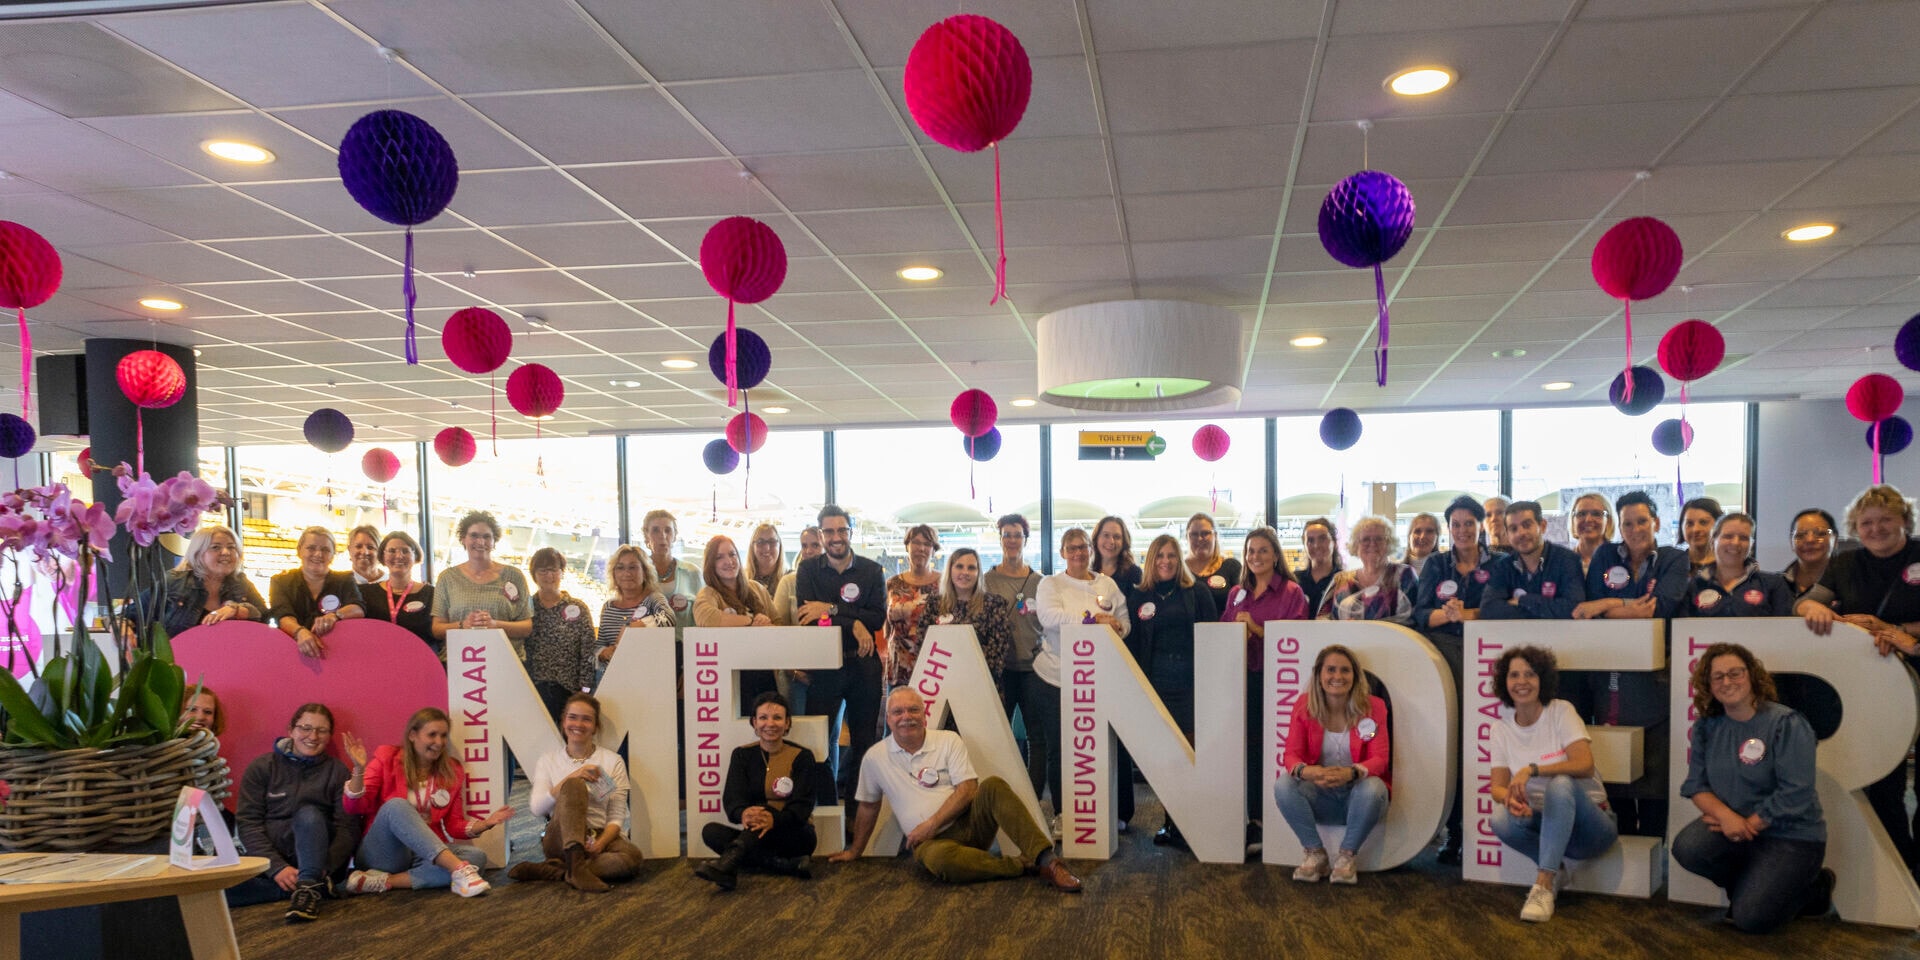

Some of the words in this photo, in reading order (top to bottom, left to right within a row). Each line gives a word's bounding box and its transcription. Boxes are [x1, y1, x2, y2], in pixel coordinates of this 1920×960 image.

[1098, 434, 1143, 442] TOILETTEN
[462, 645, 490, 763] ELKAAR
[695, 642, 720, 722] REGIE
[918, 641, 952, 727] ACHT
[446, 617, 1920, 928] MEANDER
[697, 733, 722, 813] EIGEN
[1072, 639, 1097, 845] NIEUWSGIERIG
